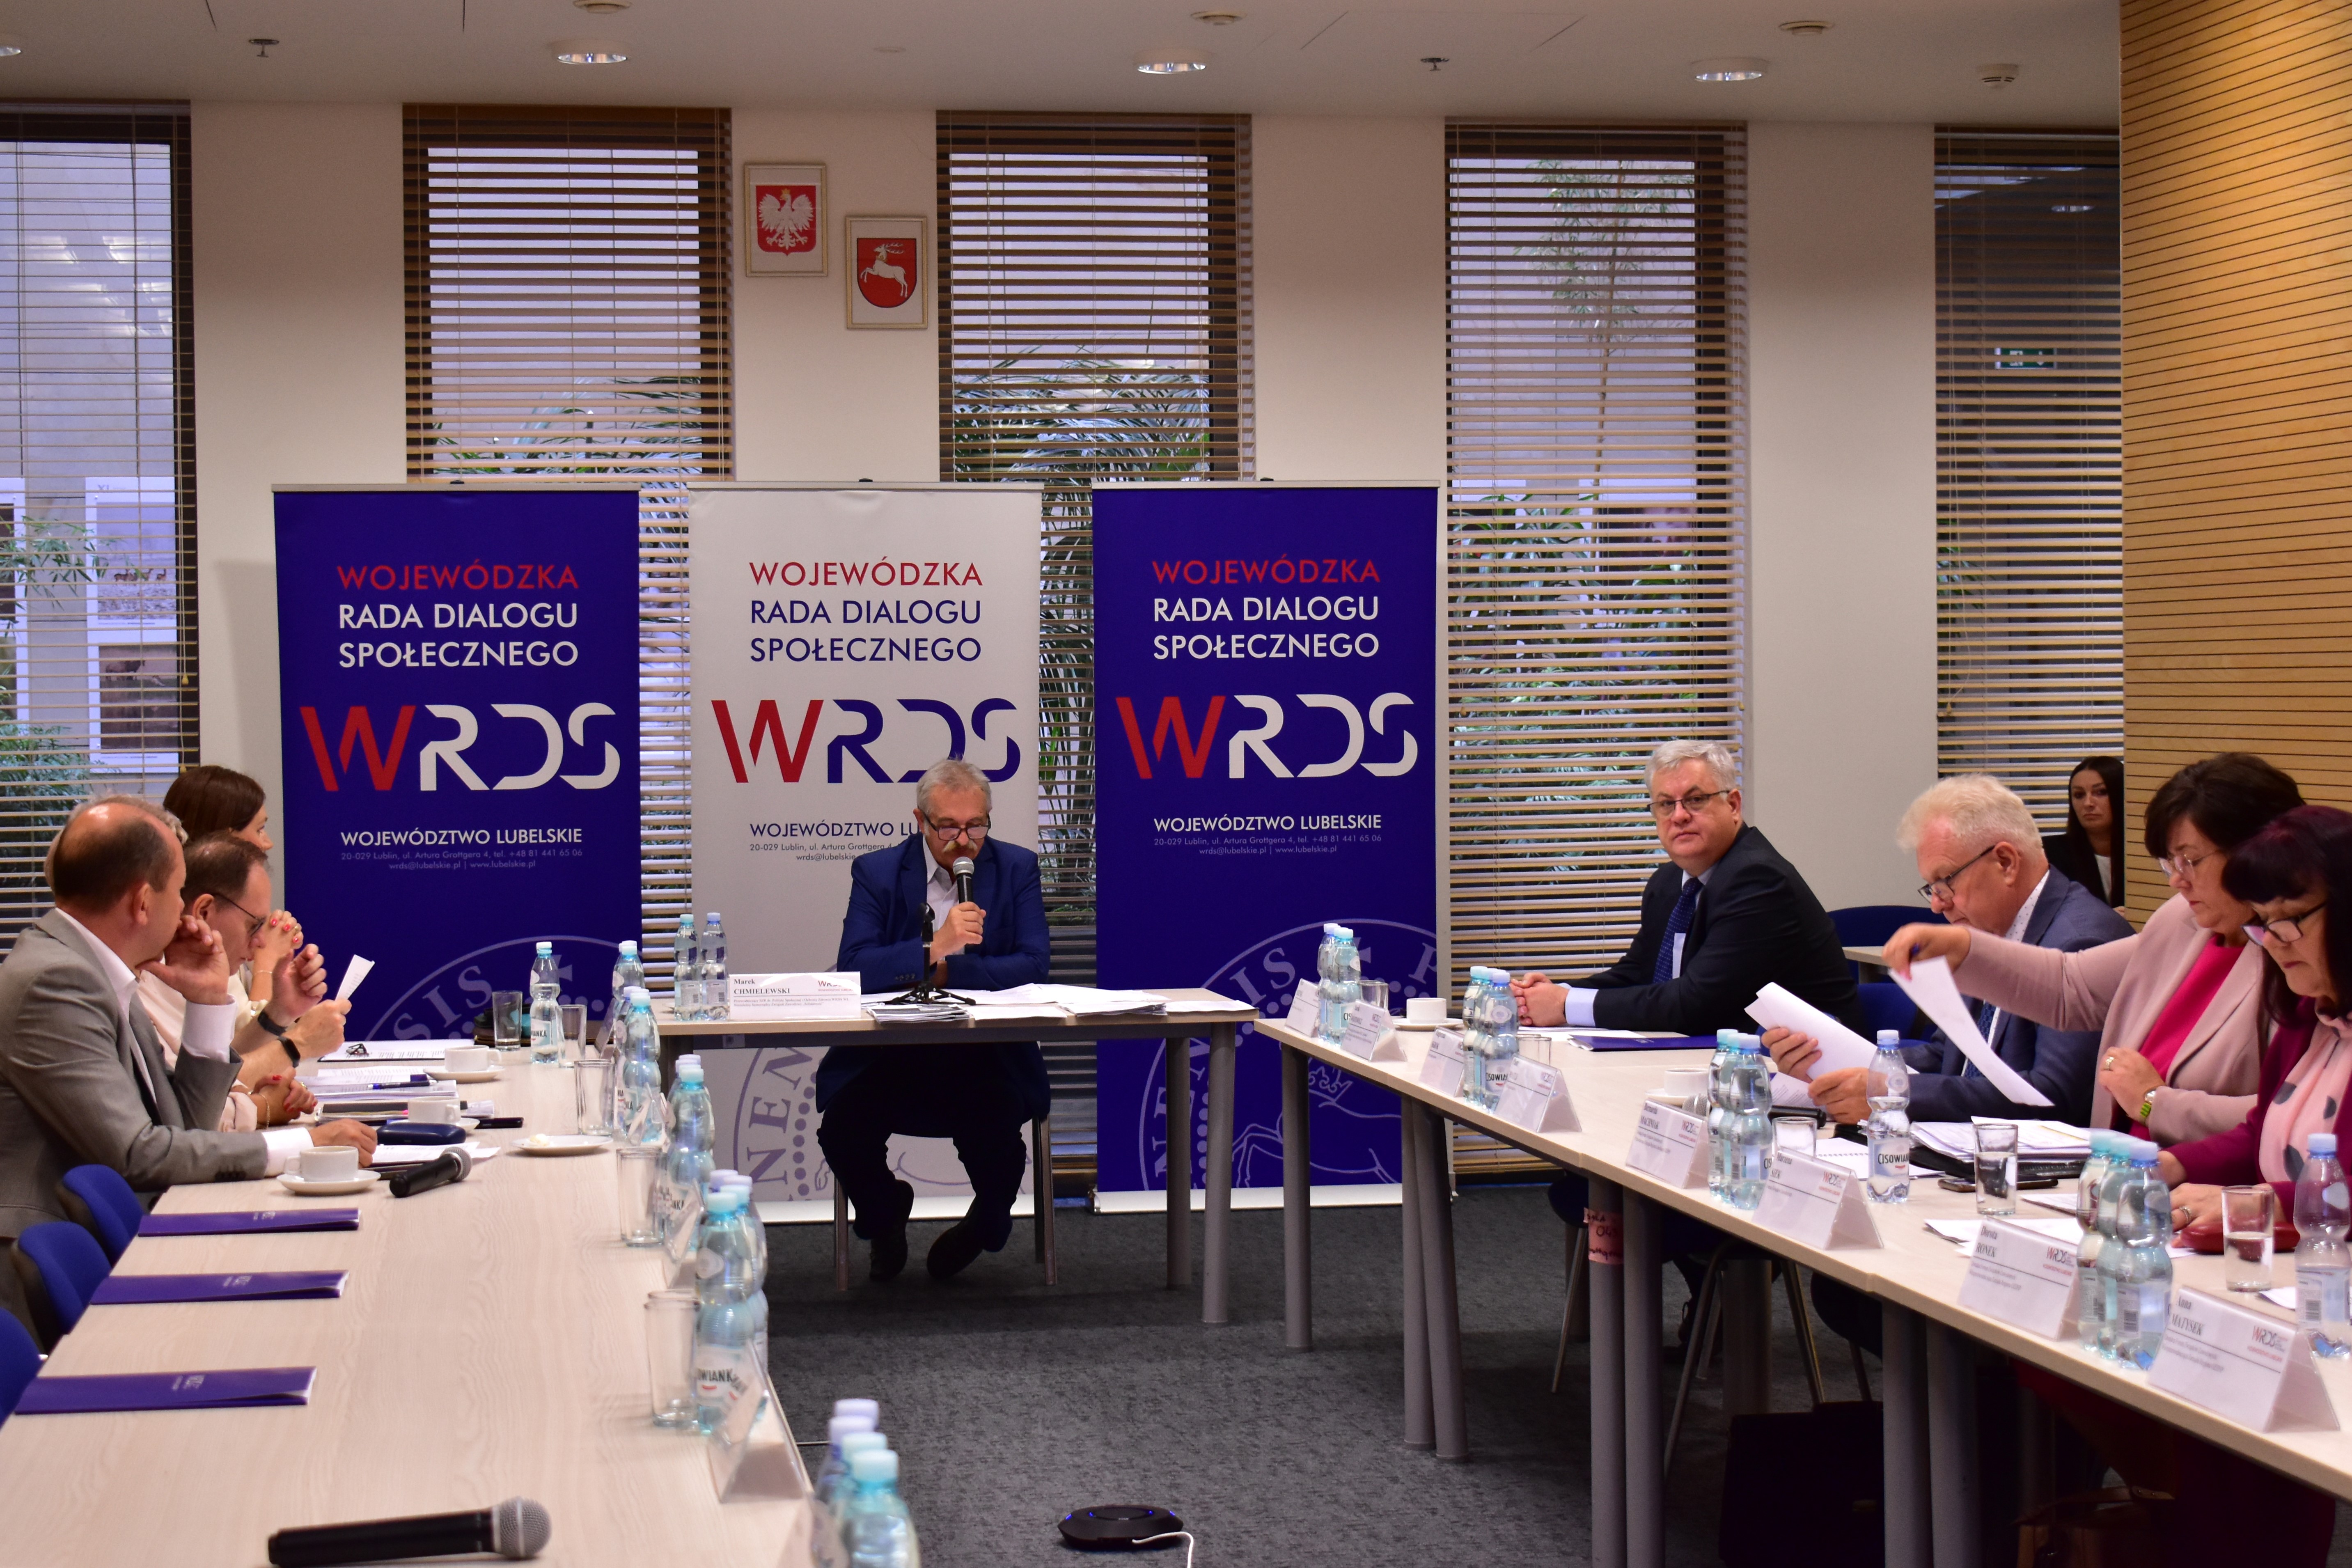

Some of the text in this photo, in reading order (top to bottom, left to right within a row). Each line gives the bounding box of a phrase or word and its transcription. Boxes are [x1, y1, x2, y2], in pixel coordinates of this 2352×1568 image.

[337, 559, 578, 590] WOJEWÓDZKA
[750, 556, 982, 586] WOJEWÓDZKA
[1152, 554, 1380, 584] WOJEWÓDZKA
[340, 603, 577, 628] RADA DIALOGU
[752, 600, 980, 624] RADA DIALOGU
[1155, 596, 1378, 621] RADA DIALOGU
[339, 641, 578, 667] SPOŁECZNEGO
[751, 638, 981, 662] SPOŁECZNEGO
[1154, 633, 1379, 659] SPOŁECZNEGO
[301, 702, 620, 791] WRDS
[711, 698, 1020, 783] WRDS
[1116, 692, 1418, 778] WRDS
[750, 820, 894, 837] WOJEWÓDZTWO
[1154, 814, 1381, 832] WOJEWÓDZTWO LUBELSKIE
[341, 828, 582, 846] WOJEWÓDZTWO LUBELSKIE
[1249, 837, 1285, 845] Grottgera
[374, 852, 399, 860] Lublin,
[442, 851, 481, 860] Grottgera
[1199, 846, 1266, 855] wrds@lubelskie.pl
[1275, 845, 1337, 853] www.lubelskie.pl
[470, 860, 536, 869] www.lubelskie.pl
[1877, 1153, 1909, 1165] CISOWIAN
[2176, 1295, 2192, 1310] Anna
